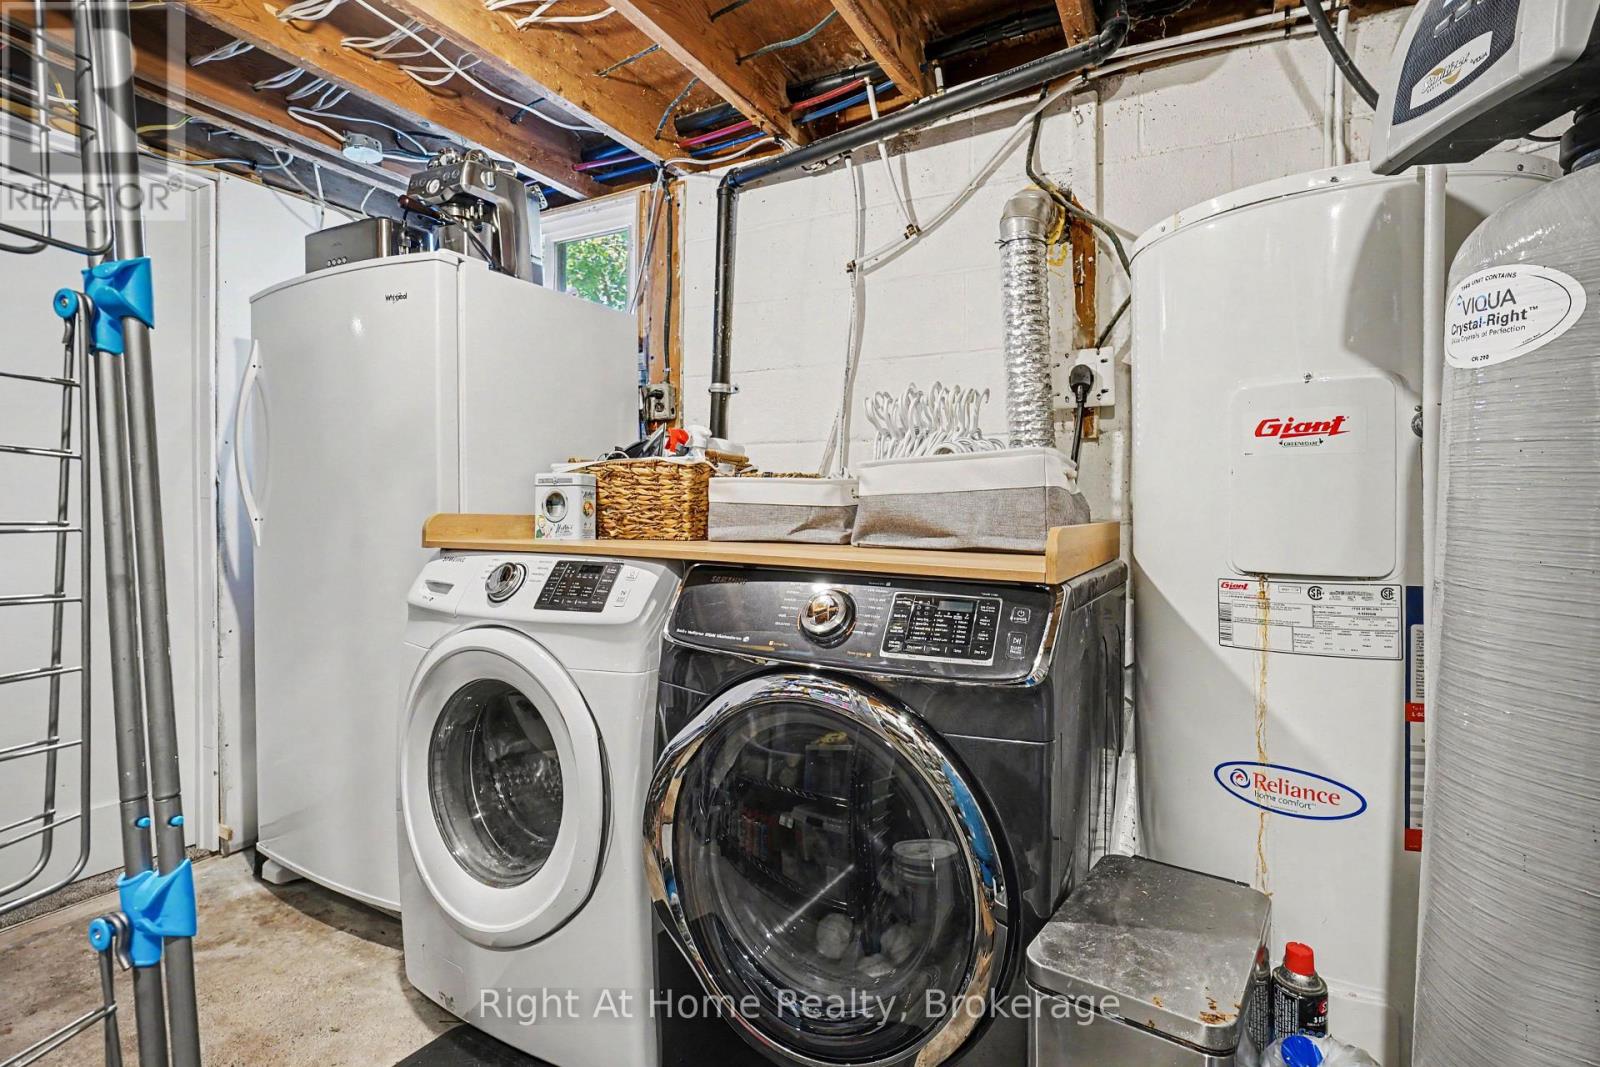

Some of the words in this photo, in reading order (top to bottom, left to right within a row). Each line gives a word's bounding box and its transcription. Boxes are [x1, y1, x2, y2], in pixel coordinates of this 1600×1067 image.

[1484, 272, 1517, 282] CONTAINS
[1462, 288, 1517, 316] VIQUA
[1488, 324, 1526, 336] Perfection
[1253, 772, 1341, 806] Reliance
